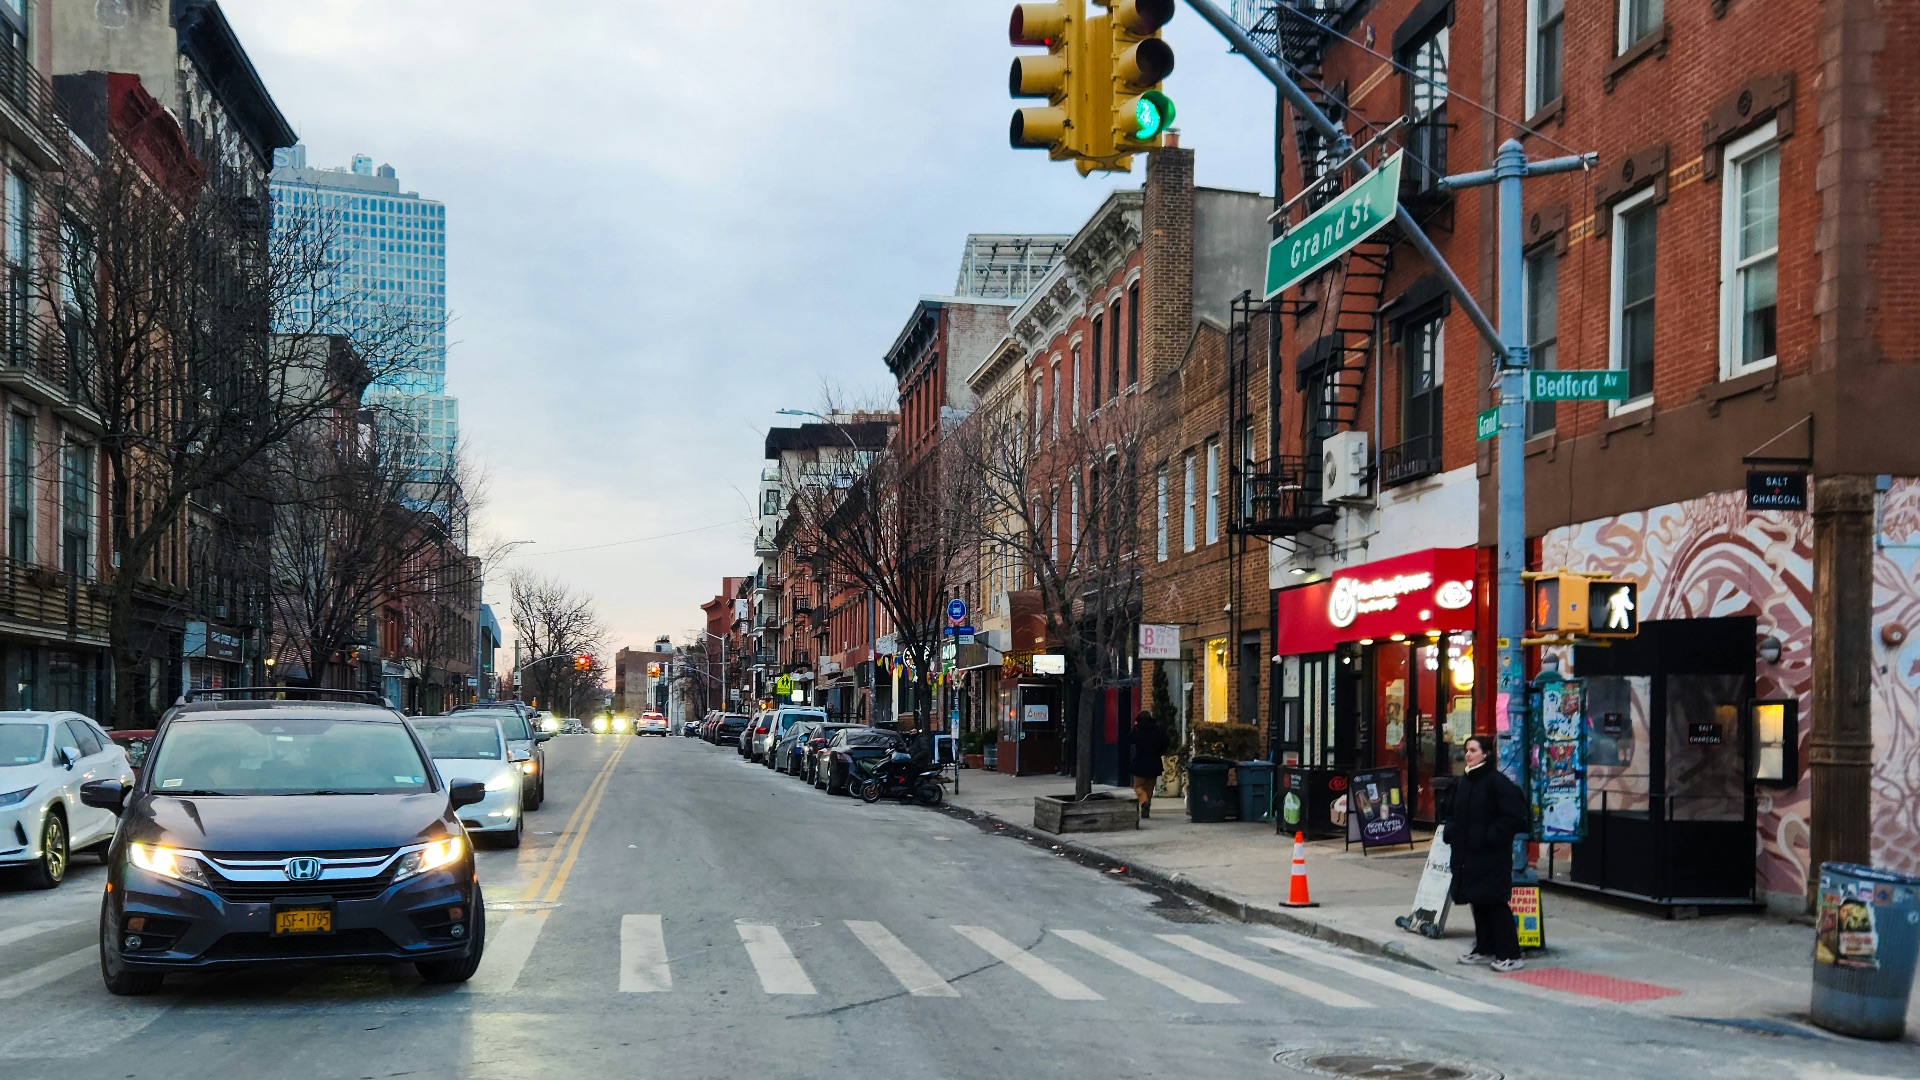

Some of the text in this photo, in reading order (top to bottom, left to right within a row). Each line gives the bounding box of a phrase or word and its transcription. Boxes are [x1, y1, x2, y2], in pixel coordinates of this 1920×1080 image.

[1290, 191, 1372, 269] Grand St
[1536, 373, 1618, 397] Bedford Av
[1479, 411, 1497, 437] Grand
[1766, 476, 1788, 487] SALT
[1752, 494, 1801, 505] CHARCOAL
[1511, 905, 1537, 913] RUCK
